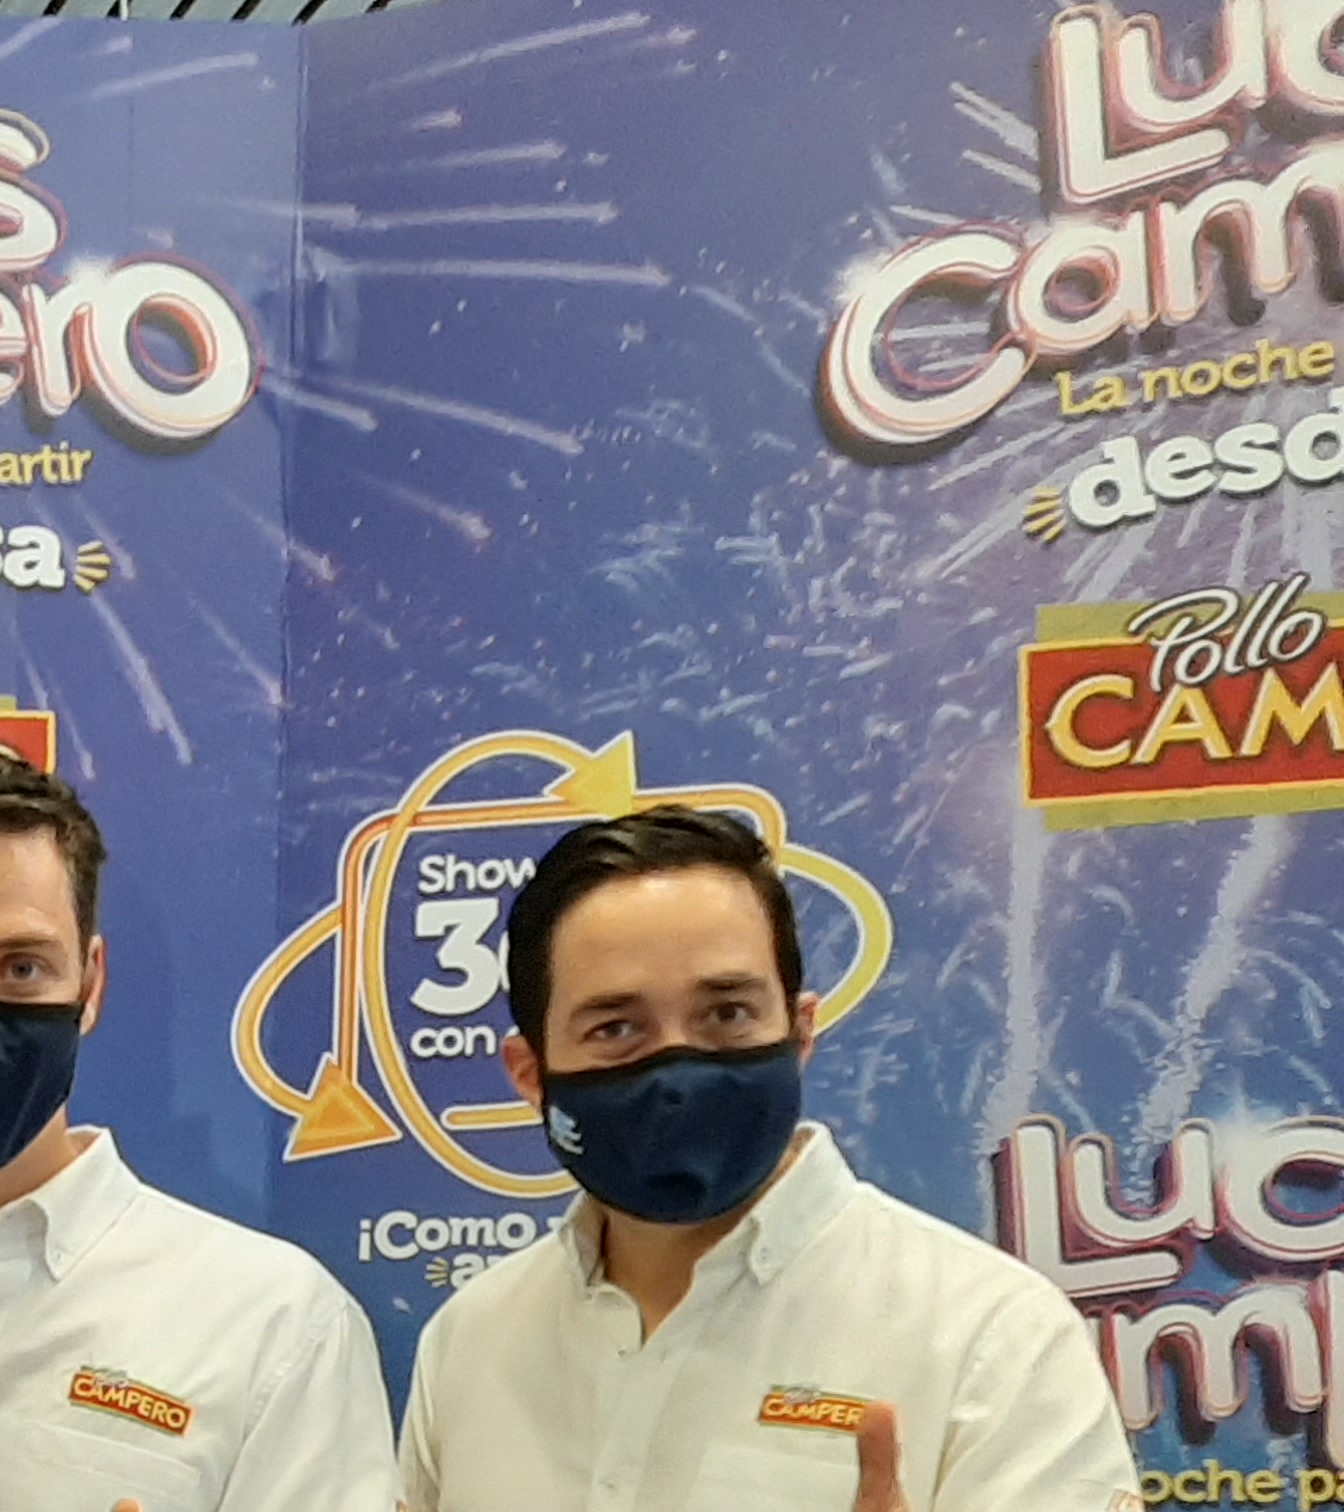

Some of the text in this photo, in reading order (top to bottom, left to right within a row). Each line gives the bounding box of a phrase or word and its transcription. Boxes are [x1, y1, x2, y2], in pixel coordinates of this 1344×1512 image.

[1056, 339, 1337, 416] La noche
[1126, 572, 1328, 693] Pollo
[417, 854, 536, 894] Show
[410, 1025, 497, 1059] con
[73, 1377, 186, 1429] CAMPERO
[763, 1398, 864, 1427] CAMPER
[1138, 1458, 1285, 1503] oche
